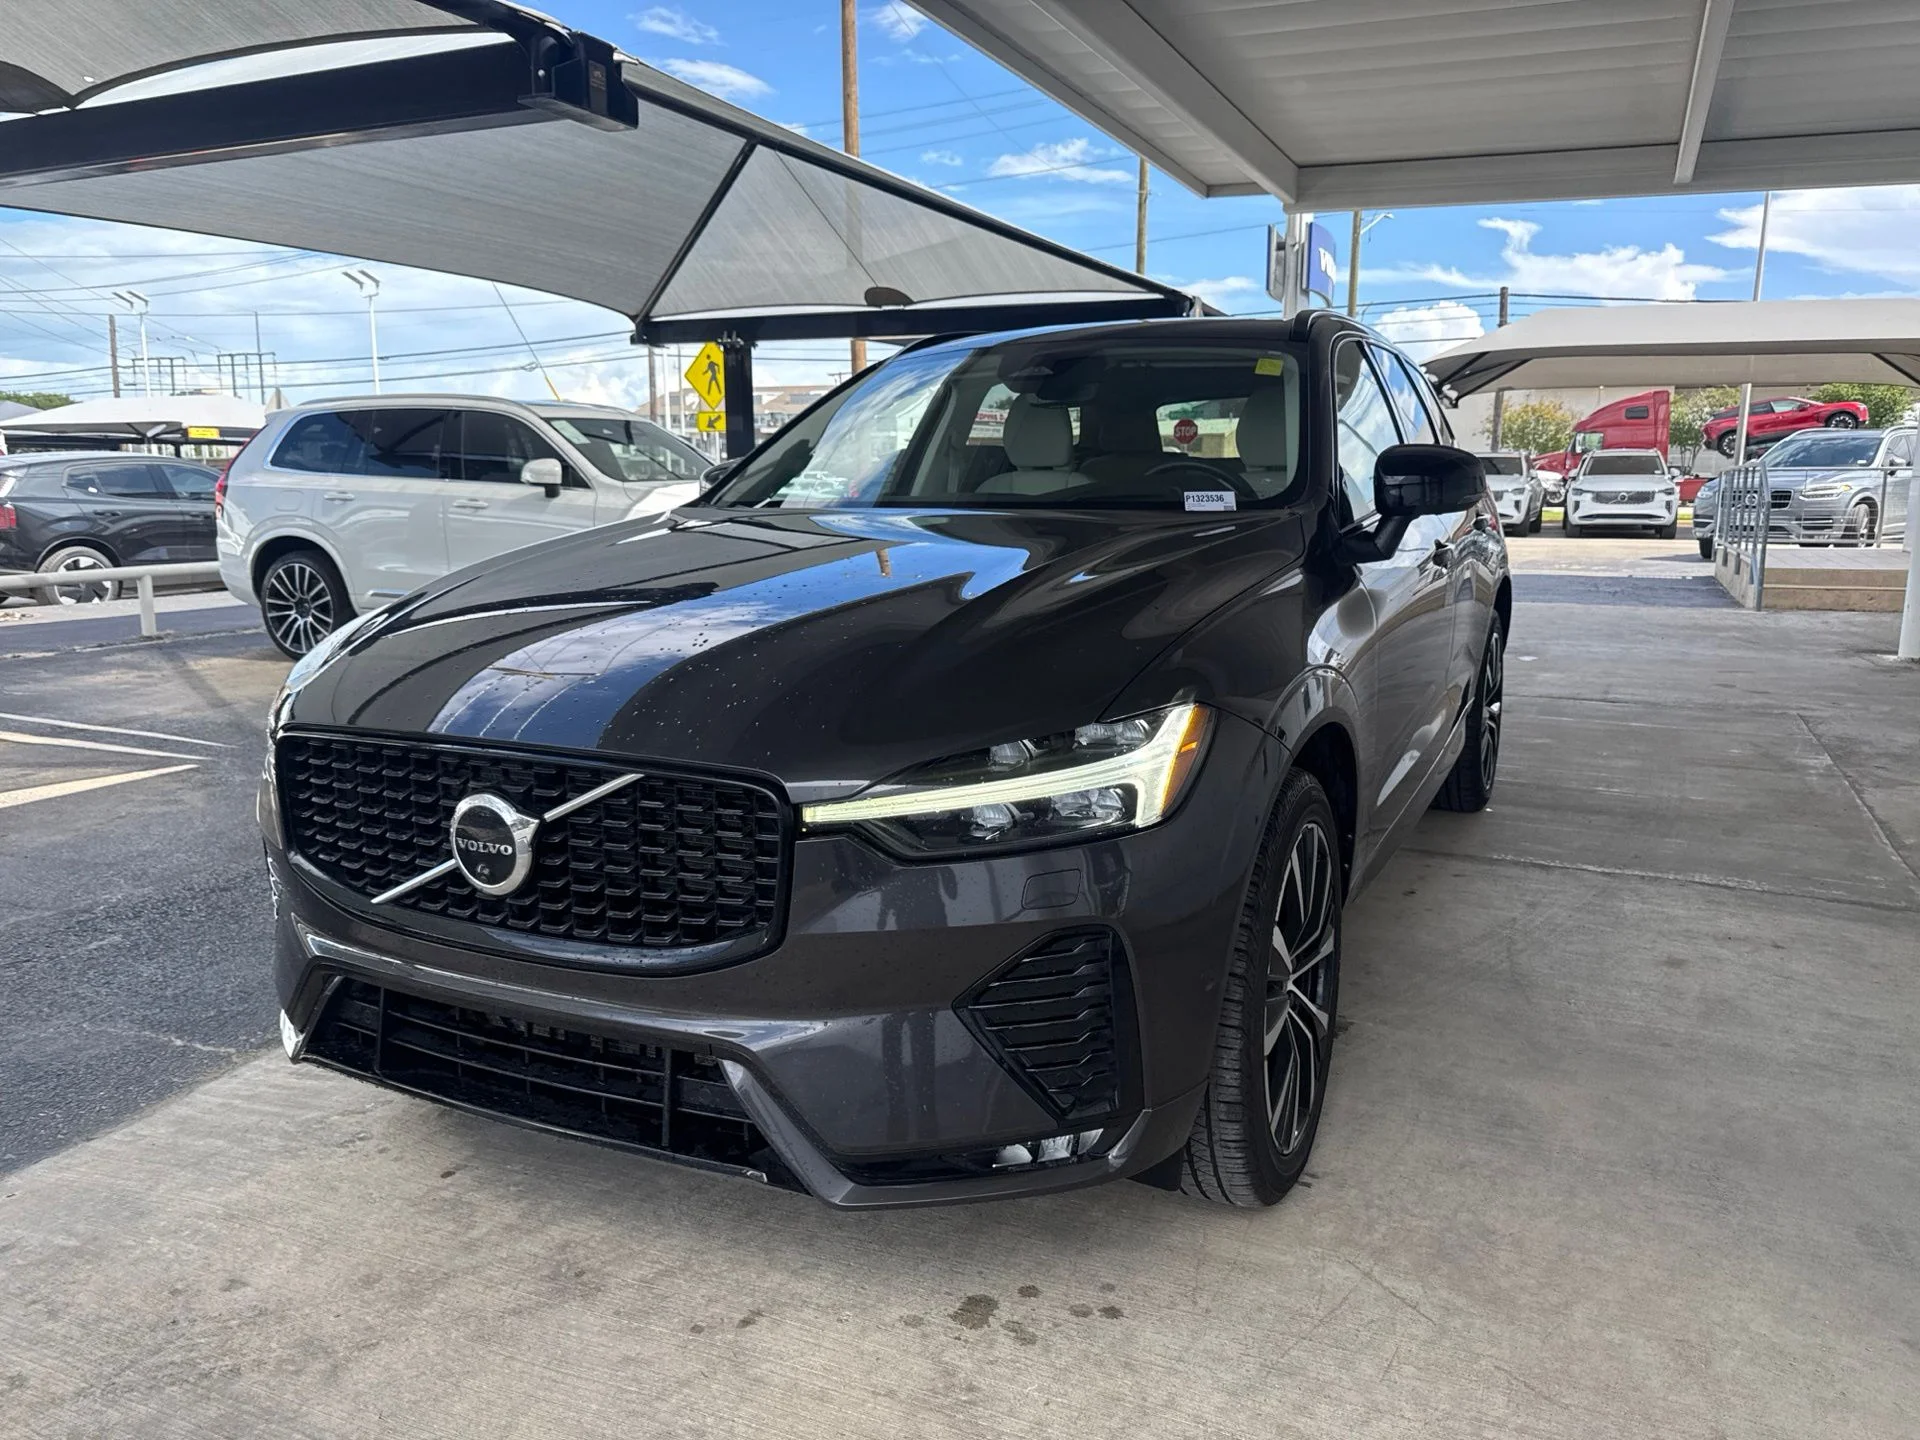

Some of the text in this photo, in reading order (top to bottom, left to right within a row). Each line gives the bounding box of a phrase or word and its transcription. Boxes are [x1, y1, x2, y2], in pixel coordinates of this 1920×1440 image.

[1175, 426, 1197, 437] STOP
[1185, 494, 1225, 503] P1323536
[456, 837, 513, 856] VOLVO
